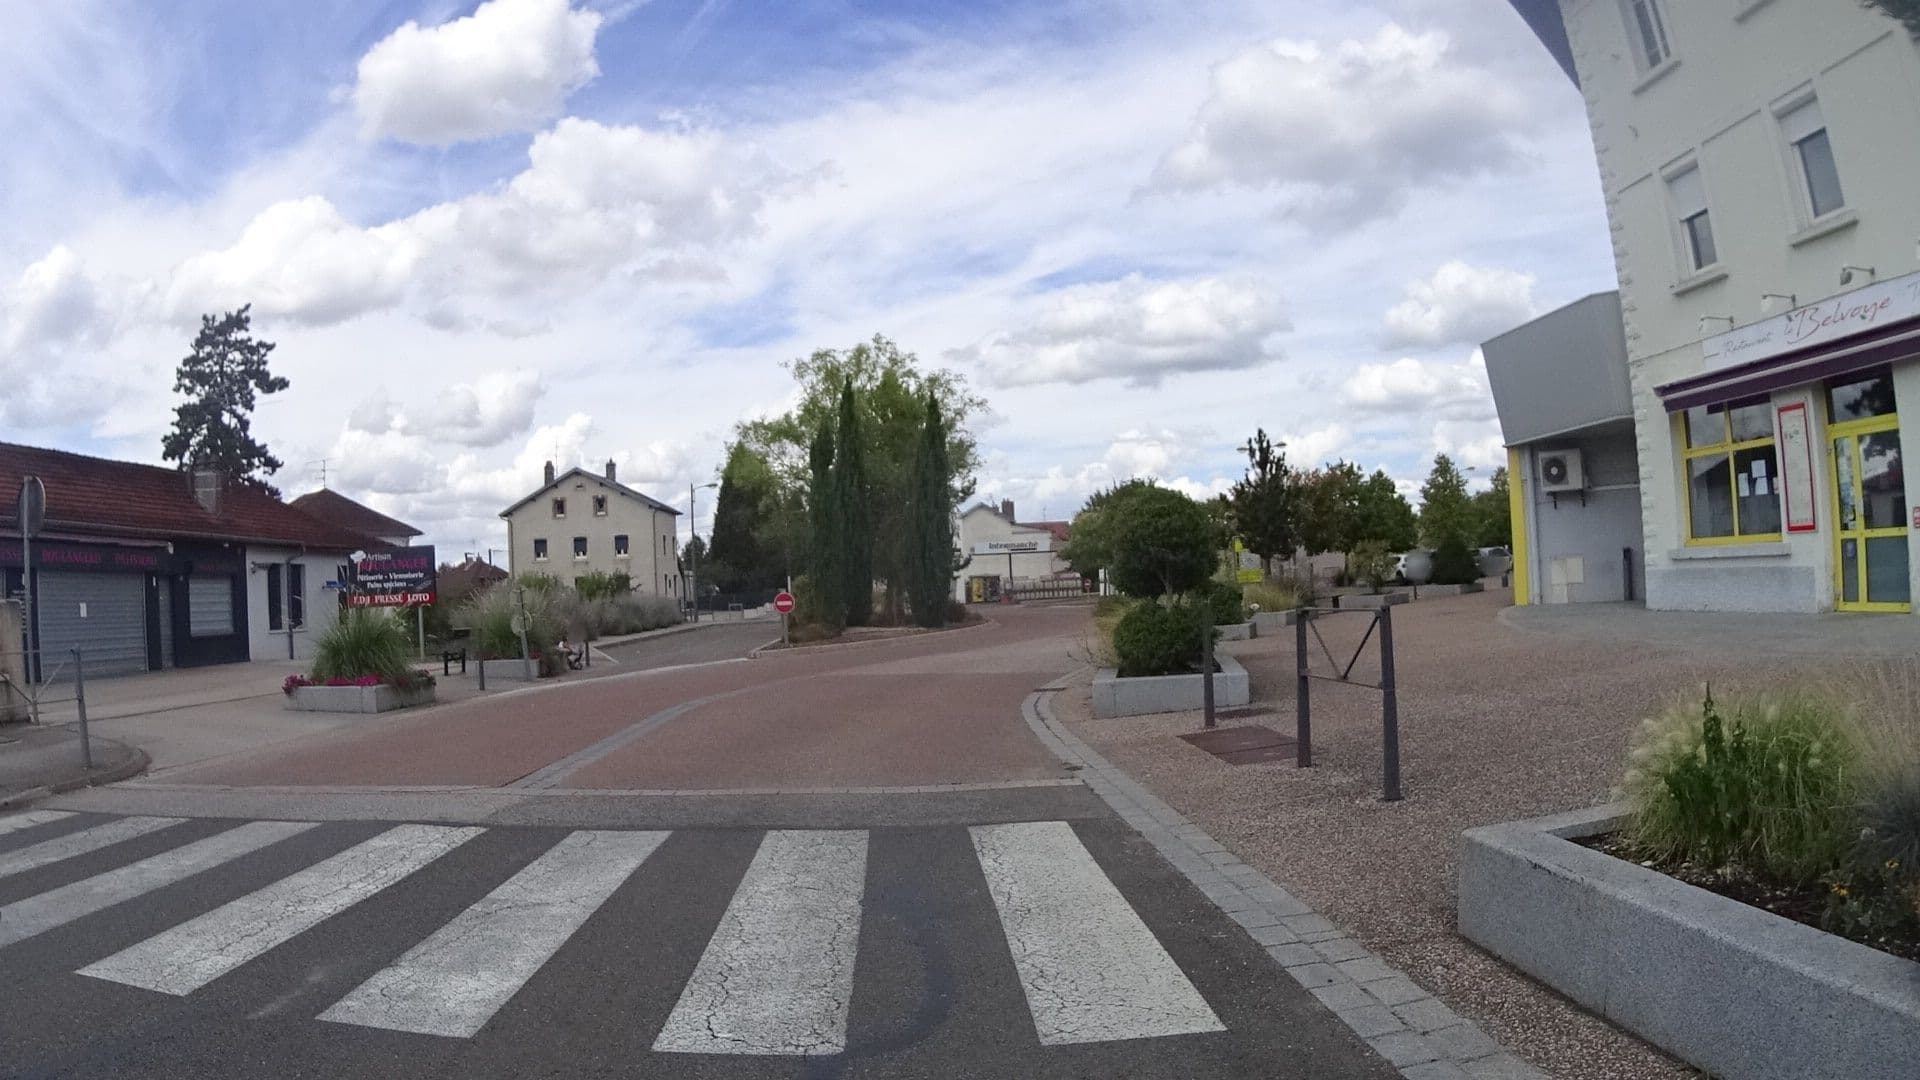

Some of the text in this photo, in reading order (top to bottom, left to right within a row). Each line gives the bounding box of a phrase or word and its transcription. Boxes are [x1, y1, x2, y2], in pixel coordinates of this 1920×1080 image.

[1787, 297, 1891, 344] Belvoye
[366, 552, 392, 561] Artisan
[375, 593, 404, 604] PRESSE
[407, 593, 430, 602] LOTO
